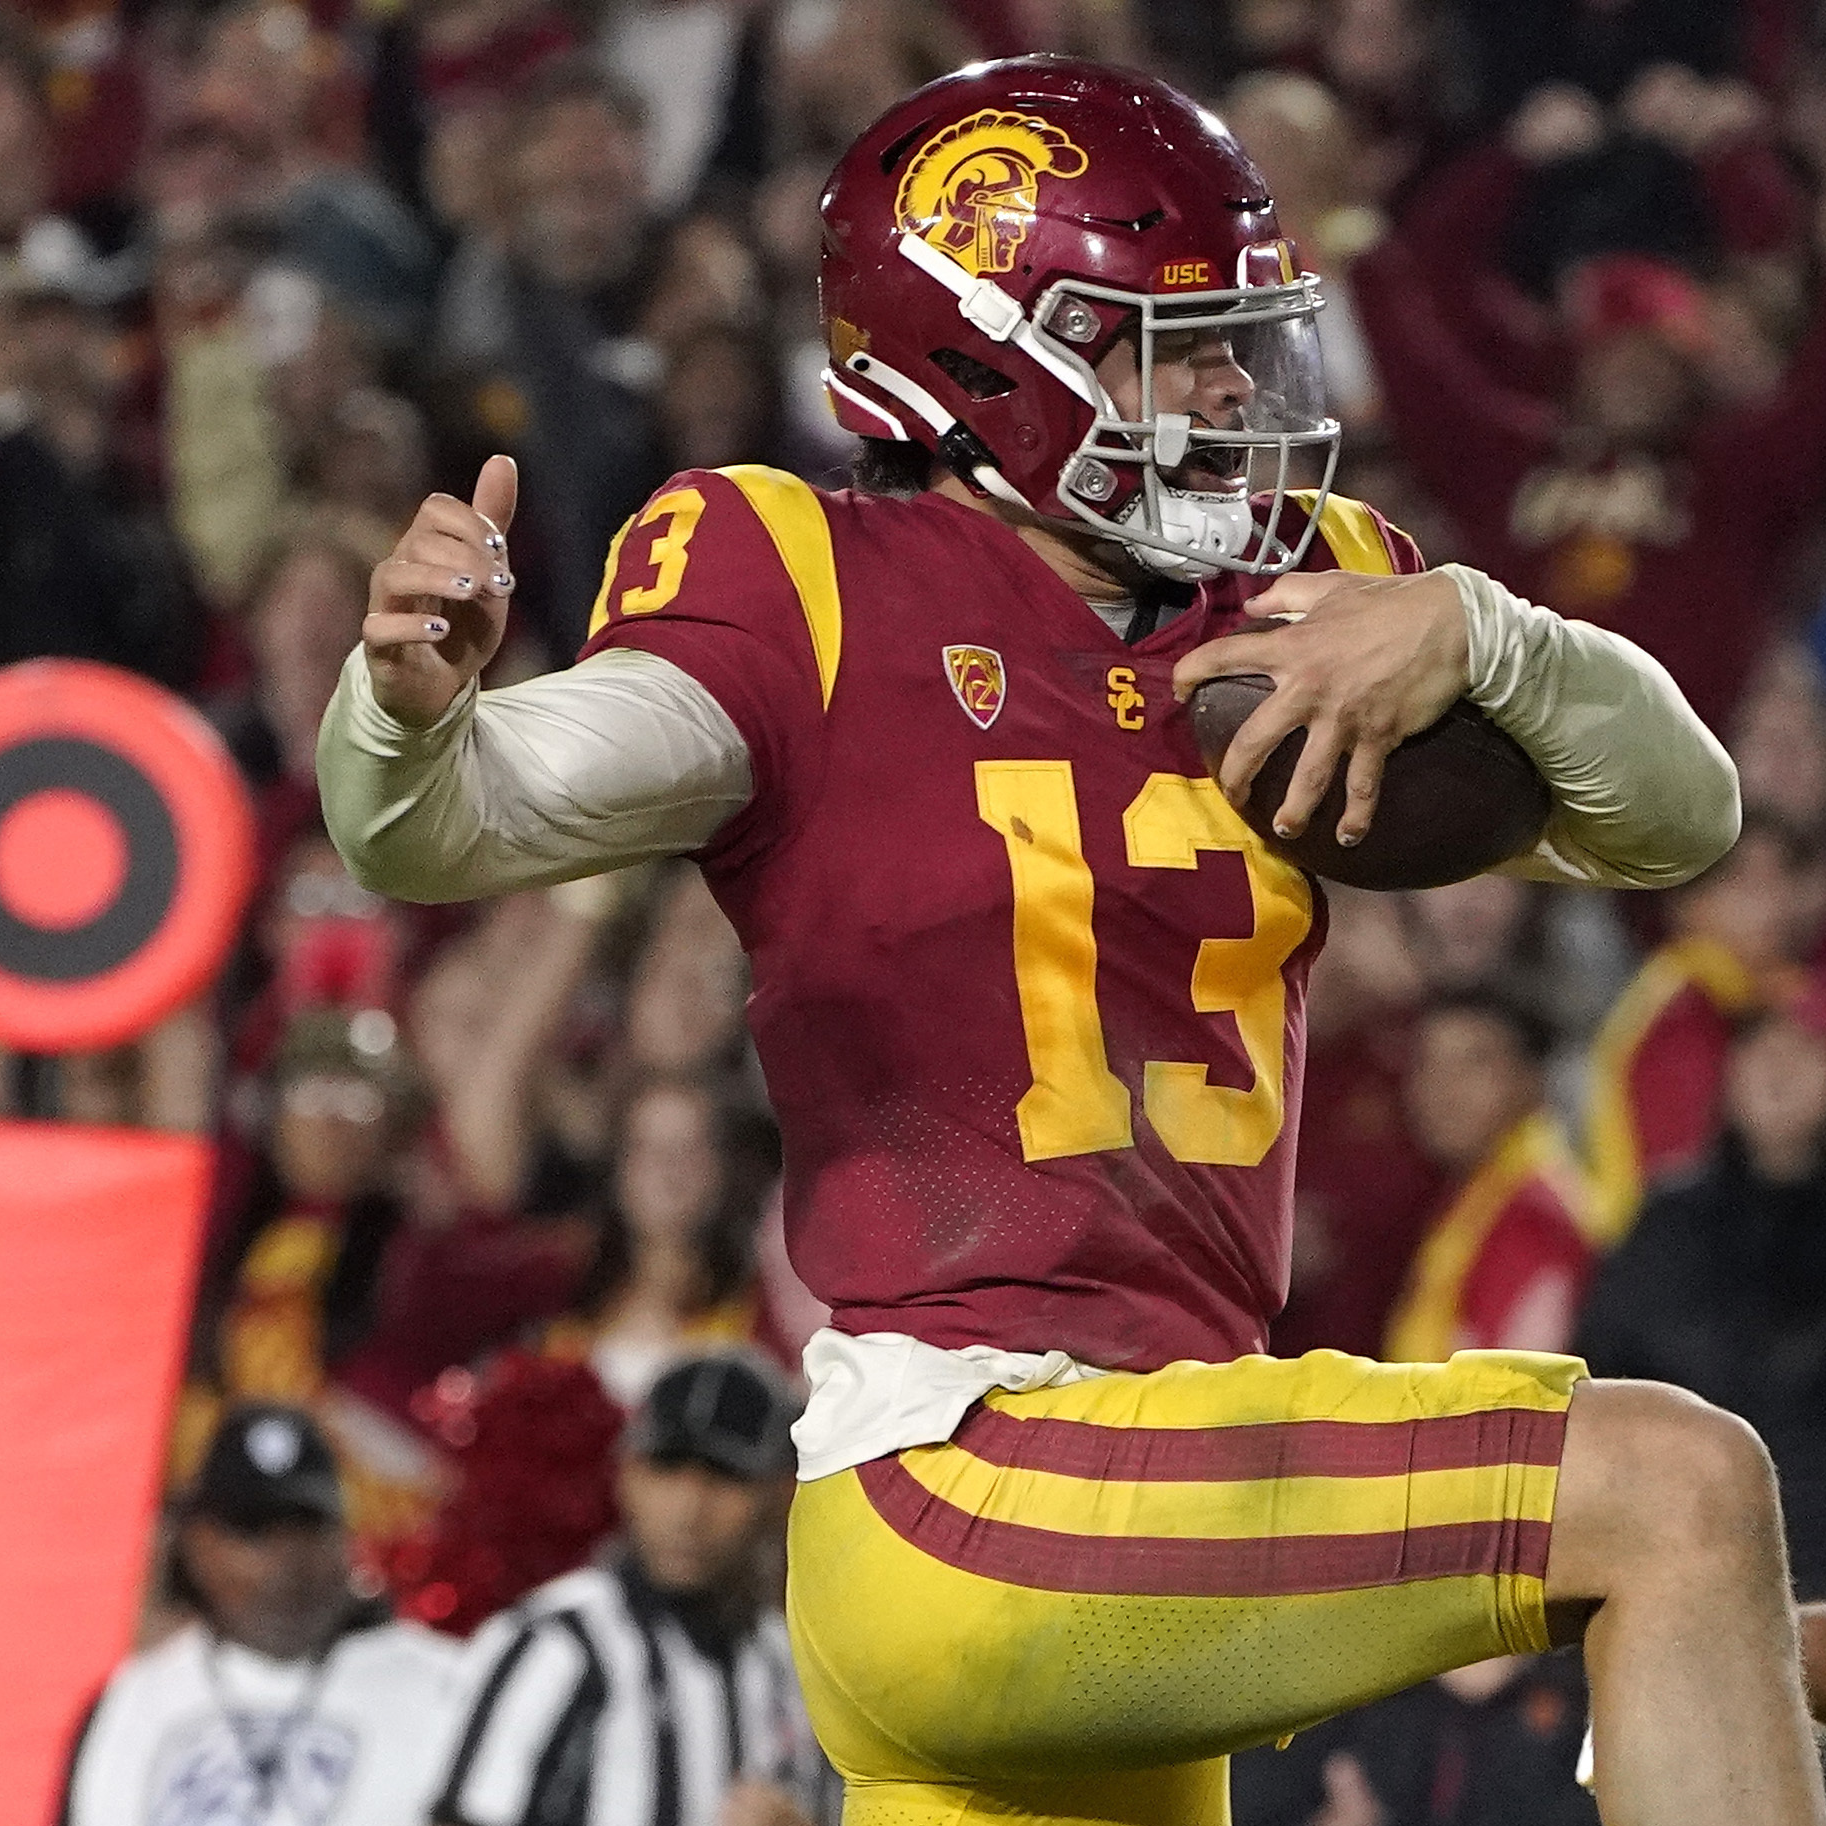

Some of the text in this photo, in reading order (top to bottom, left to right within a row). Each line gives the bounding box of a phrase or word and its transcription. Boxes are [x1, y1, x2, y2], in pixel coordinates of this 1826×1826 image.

[1163, 262, 1209, 285] USC
[1107, 666, 1145, 730] SC
[974, 759, 1313, 1167] 13
